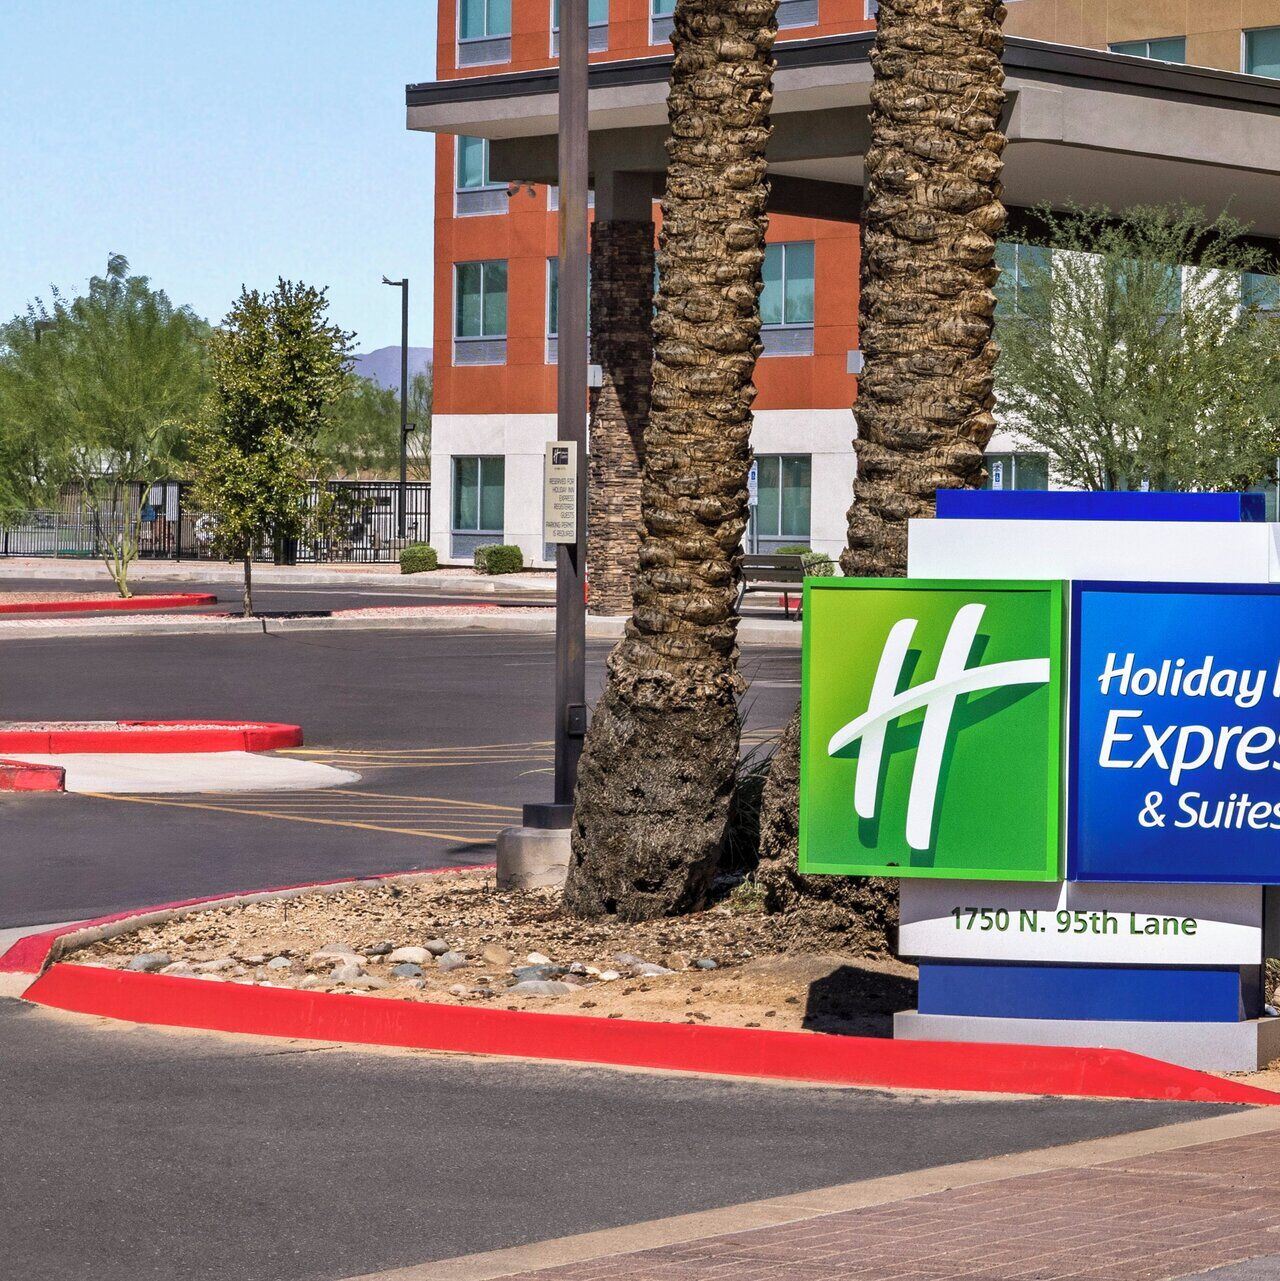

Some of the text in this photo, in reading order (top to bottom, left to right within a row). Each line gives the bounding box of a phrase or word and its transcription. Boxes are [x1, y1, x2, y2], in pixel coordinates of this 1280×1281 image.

[1098, 652, 1268, 708] Holiday
[1138, 790, 1166, 828] &
[950, 906, 1198, 936] 1750 N. 95th Lane
